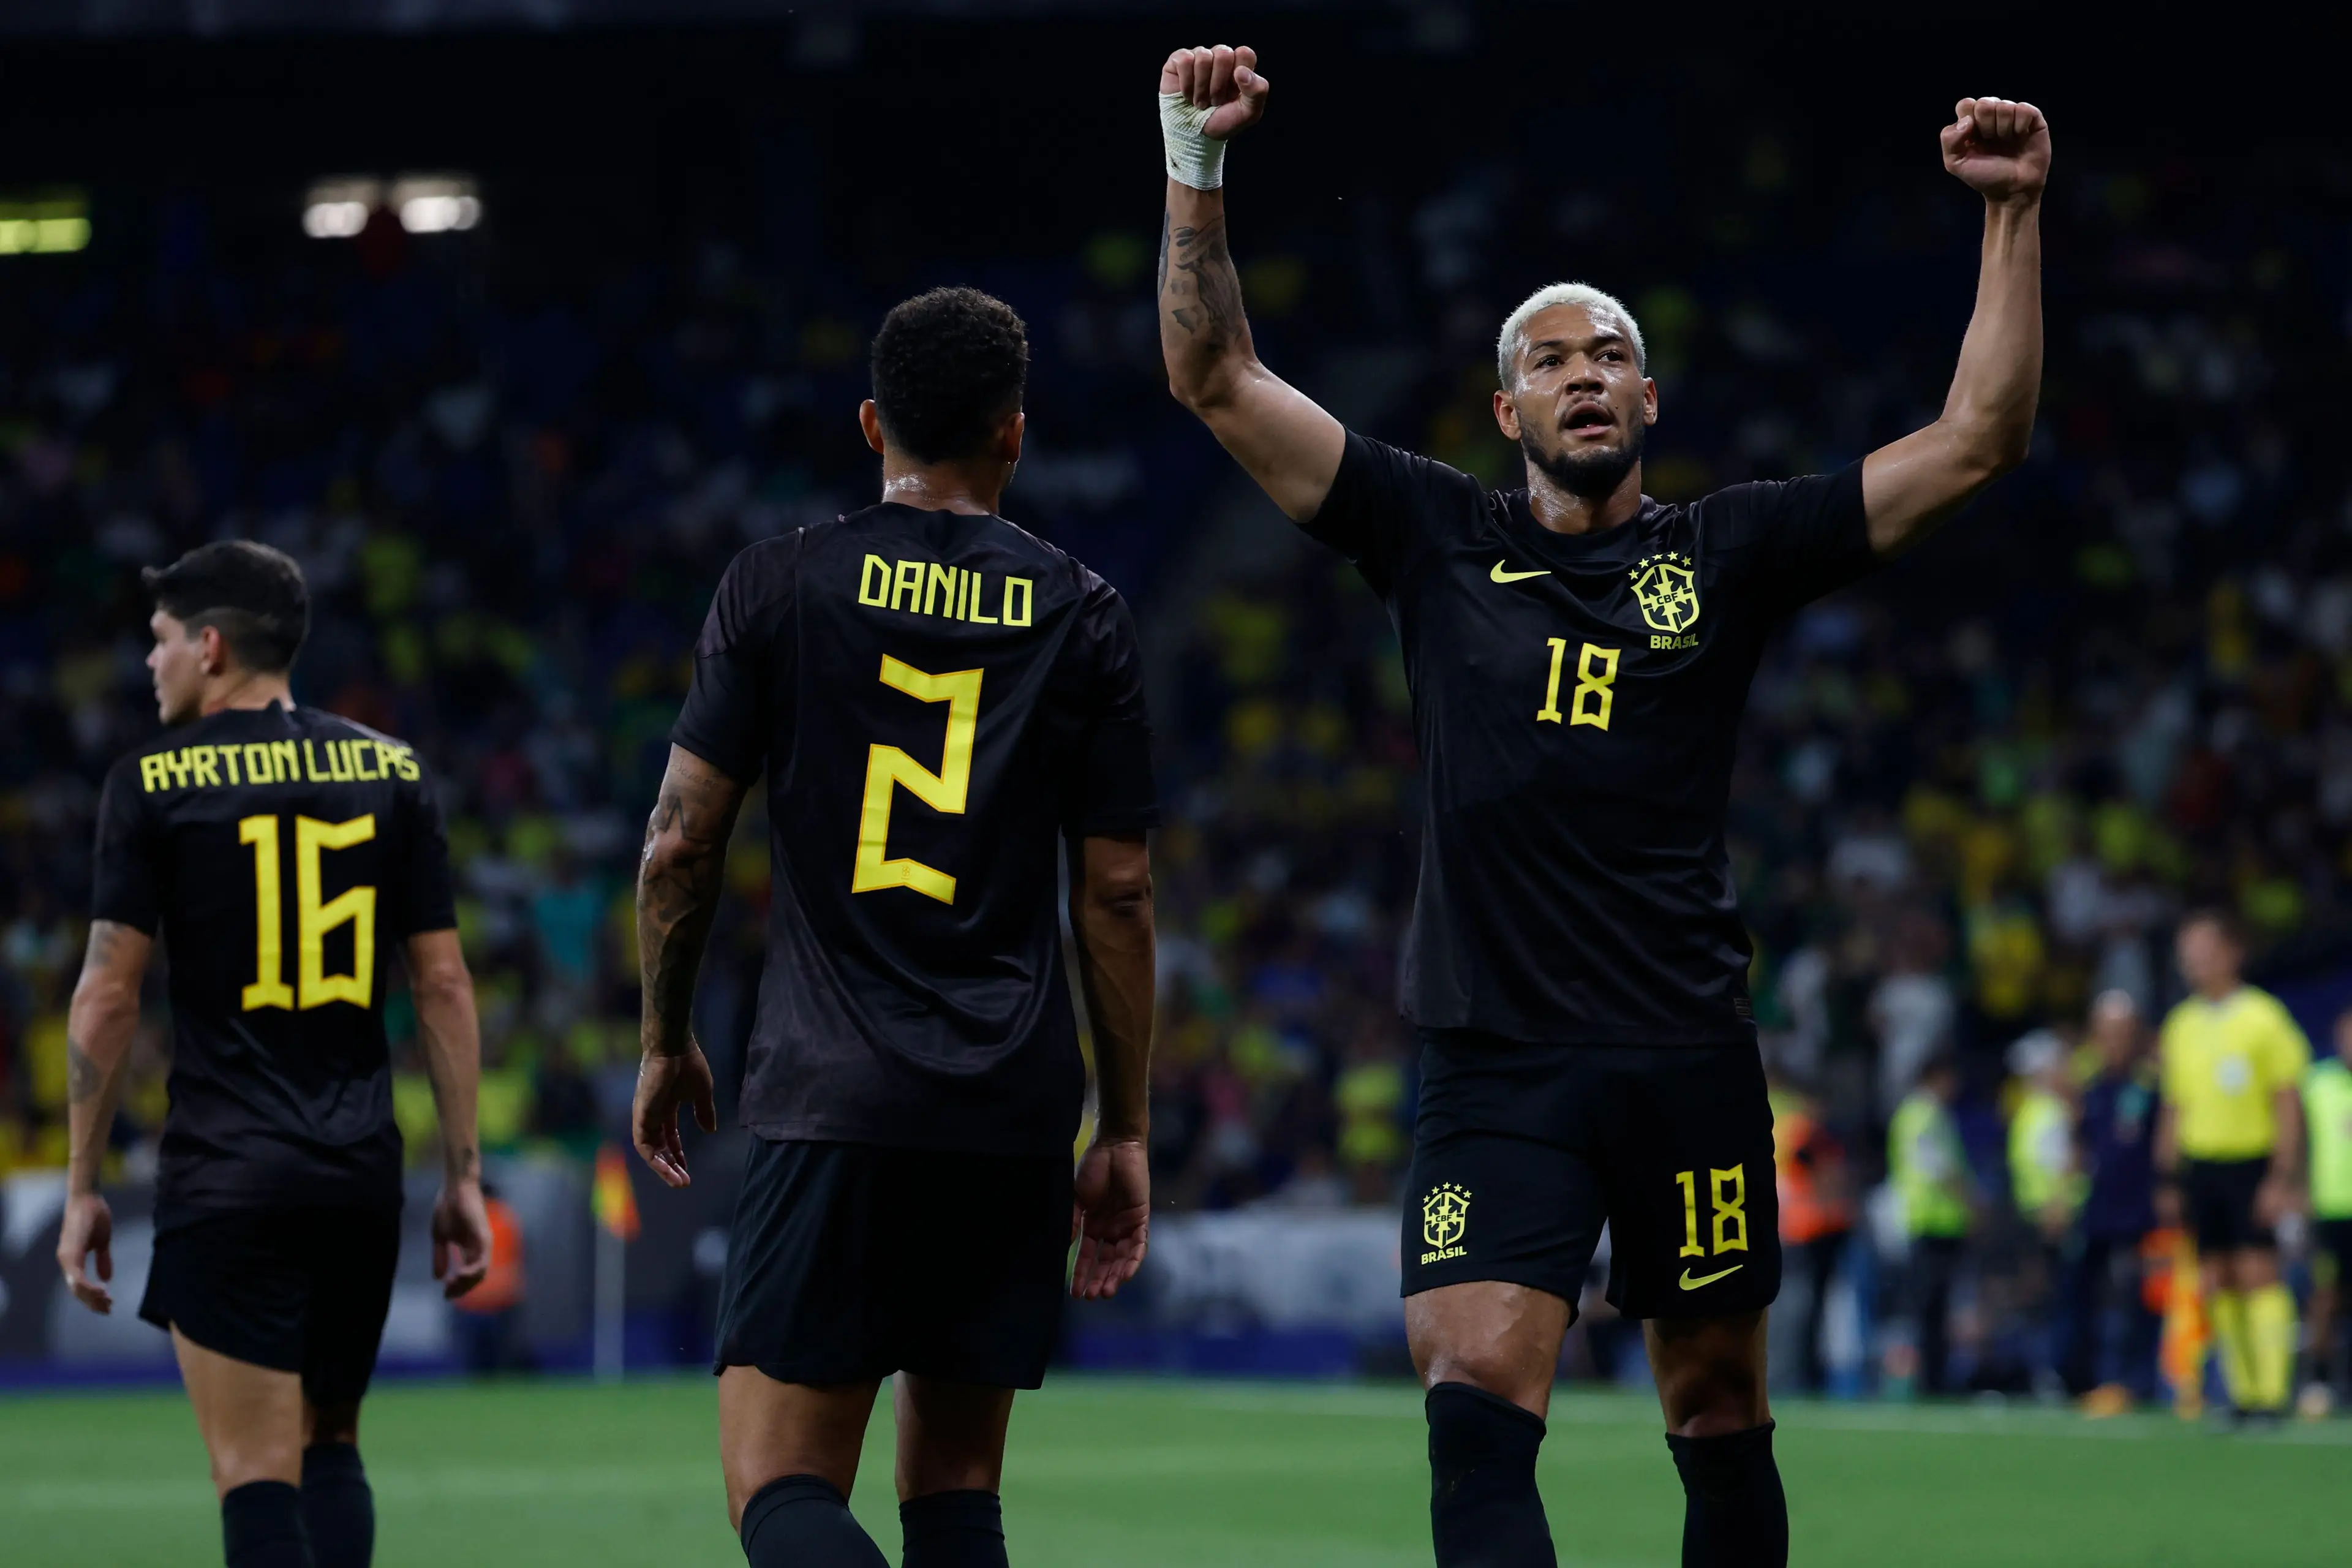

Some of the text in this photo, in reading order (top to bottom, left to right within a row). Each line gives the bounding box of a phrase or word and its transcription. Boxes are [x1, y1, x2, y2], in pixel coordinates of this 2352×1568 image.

[858, 554, 1033, 627] DANILO
[1656, 592, 1678, 605] CBF
[1650, 633, 1699, 650] BRASIL
[1537, 637, 1621, 731] 18
[140, 738, 421, 793] AYRTON LUCAS
[851, 653, 984, 906] 2
[238, 813, 376, 1011] 16
[1676, 1163, 1749, 1258] 18
[1421, 1246, 1468, 1265] BRASIL
